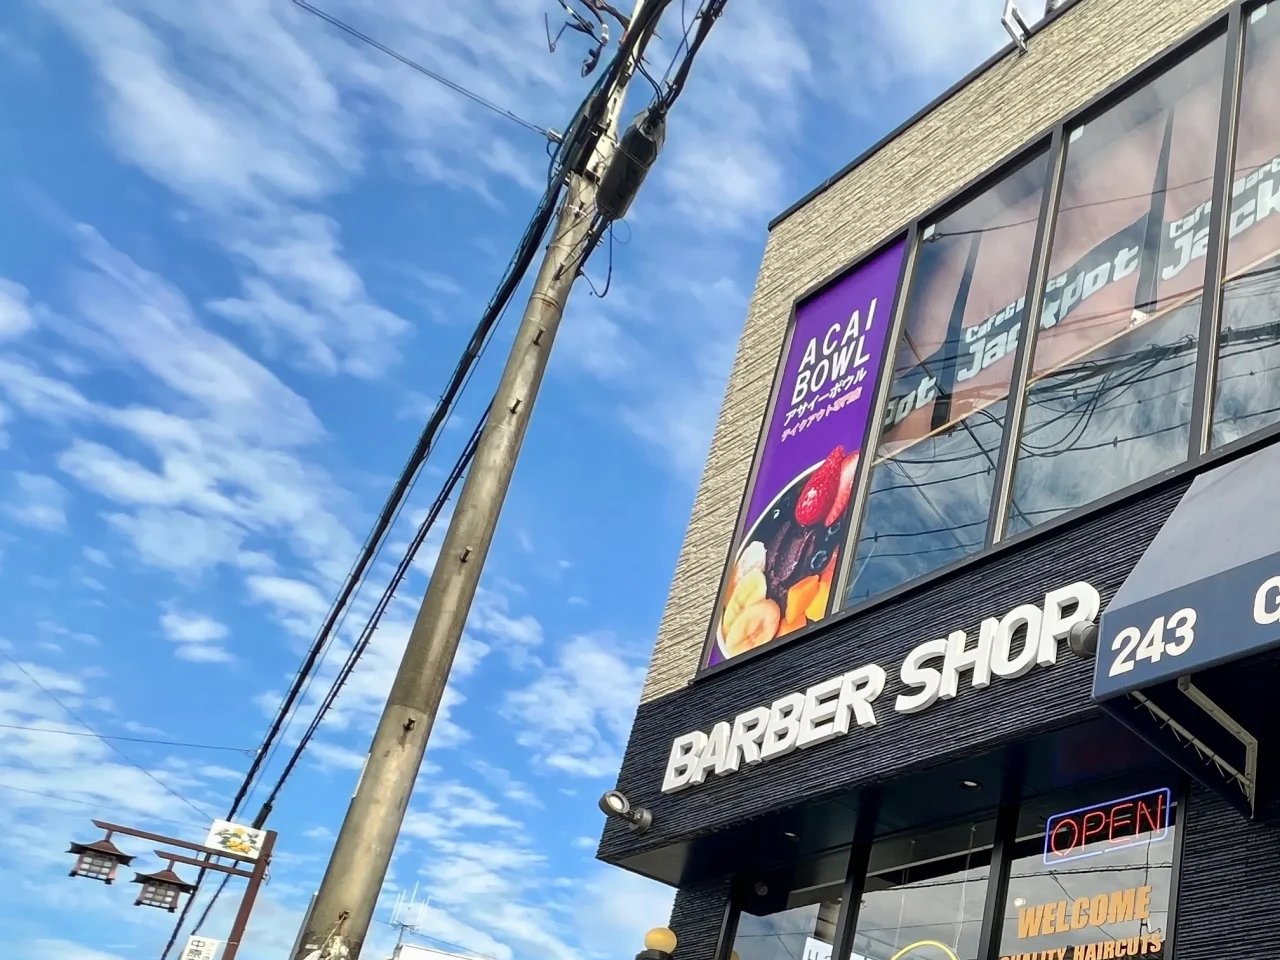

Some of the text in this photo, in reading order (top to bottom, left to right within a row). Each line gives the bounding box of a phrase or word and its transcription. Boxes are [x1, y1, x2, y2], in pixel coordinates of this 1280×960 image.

[791, 335, 871, 406] BOWL
[798, 298, 878, 373] ACAI
[784, 367, 868, 427] アサイーボウル
[1108, 607, 1197, 679] 243
[661, 581, 1101, 795] BARBER SHOP
[1051, 794, 1163, 857] OPEN
[1017, 885, 1153, 940] WELCOME
